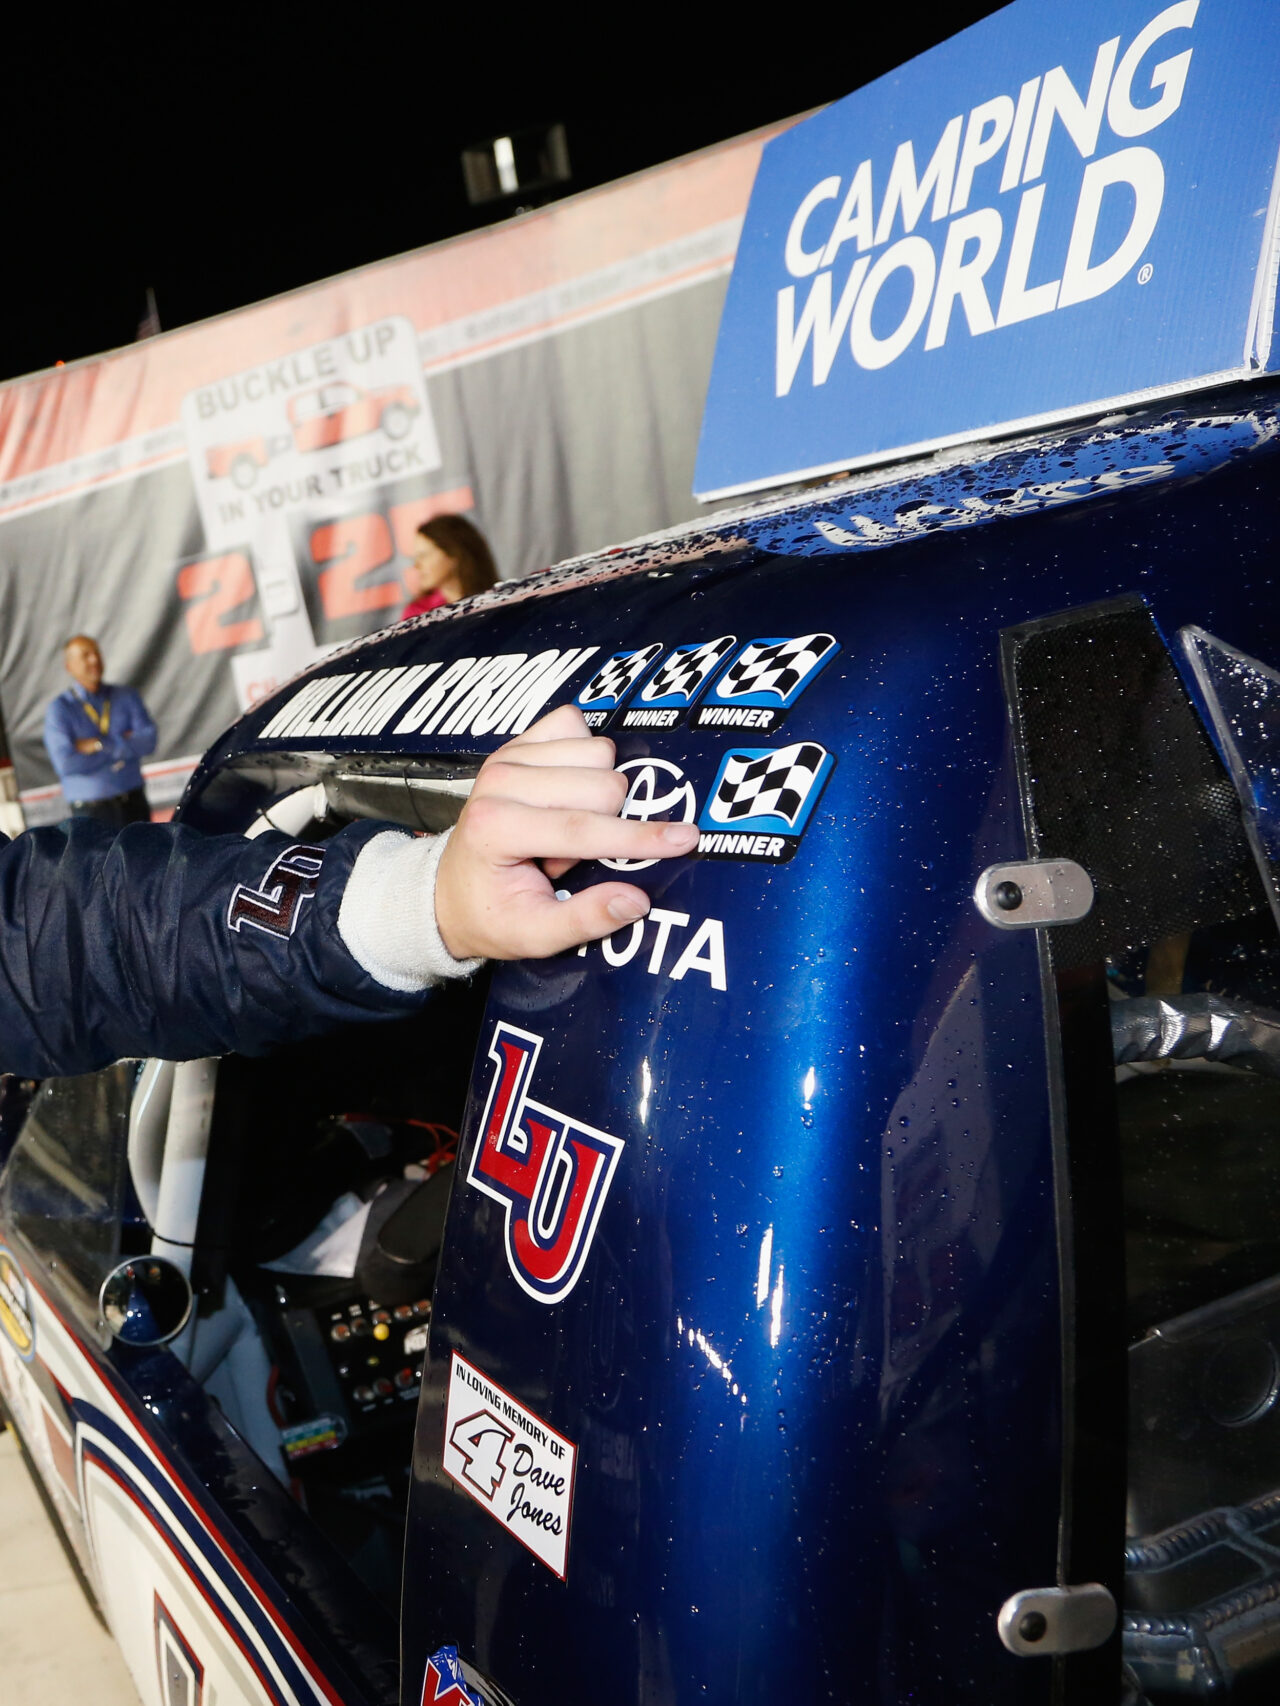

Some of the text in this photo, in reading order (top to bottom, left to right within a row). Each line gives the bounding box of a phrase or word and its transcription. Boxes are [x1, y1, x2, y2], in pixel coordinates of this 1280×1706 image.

[785, 0, 1201, 278] CAMPING
[775, 146, 1165, 398] WORLD
[195, 326, 396, 420] BUCKLE UP
[219, 445, 423, 523] IN YOUR TRUCK
[258, 647, 600, 739] WILLIAM BYRON
[583, 711, 608, 728] NER
[622, 709, 680, 727] WINNER
[698, 707, 775, 729] WINNER
[697, 834, 785, 857] WINNER
[577, 907, 727, 991] OTA
[456, 1363, 566, 1459] IN LOVING MEMORY OF
[449, 1408, 516, 1502] 4
[513, 1443, 566, 1497] Dave
[506, 1482, 563, 1536] Jones
